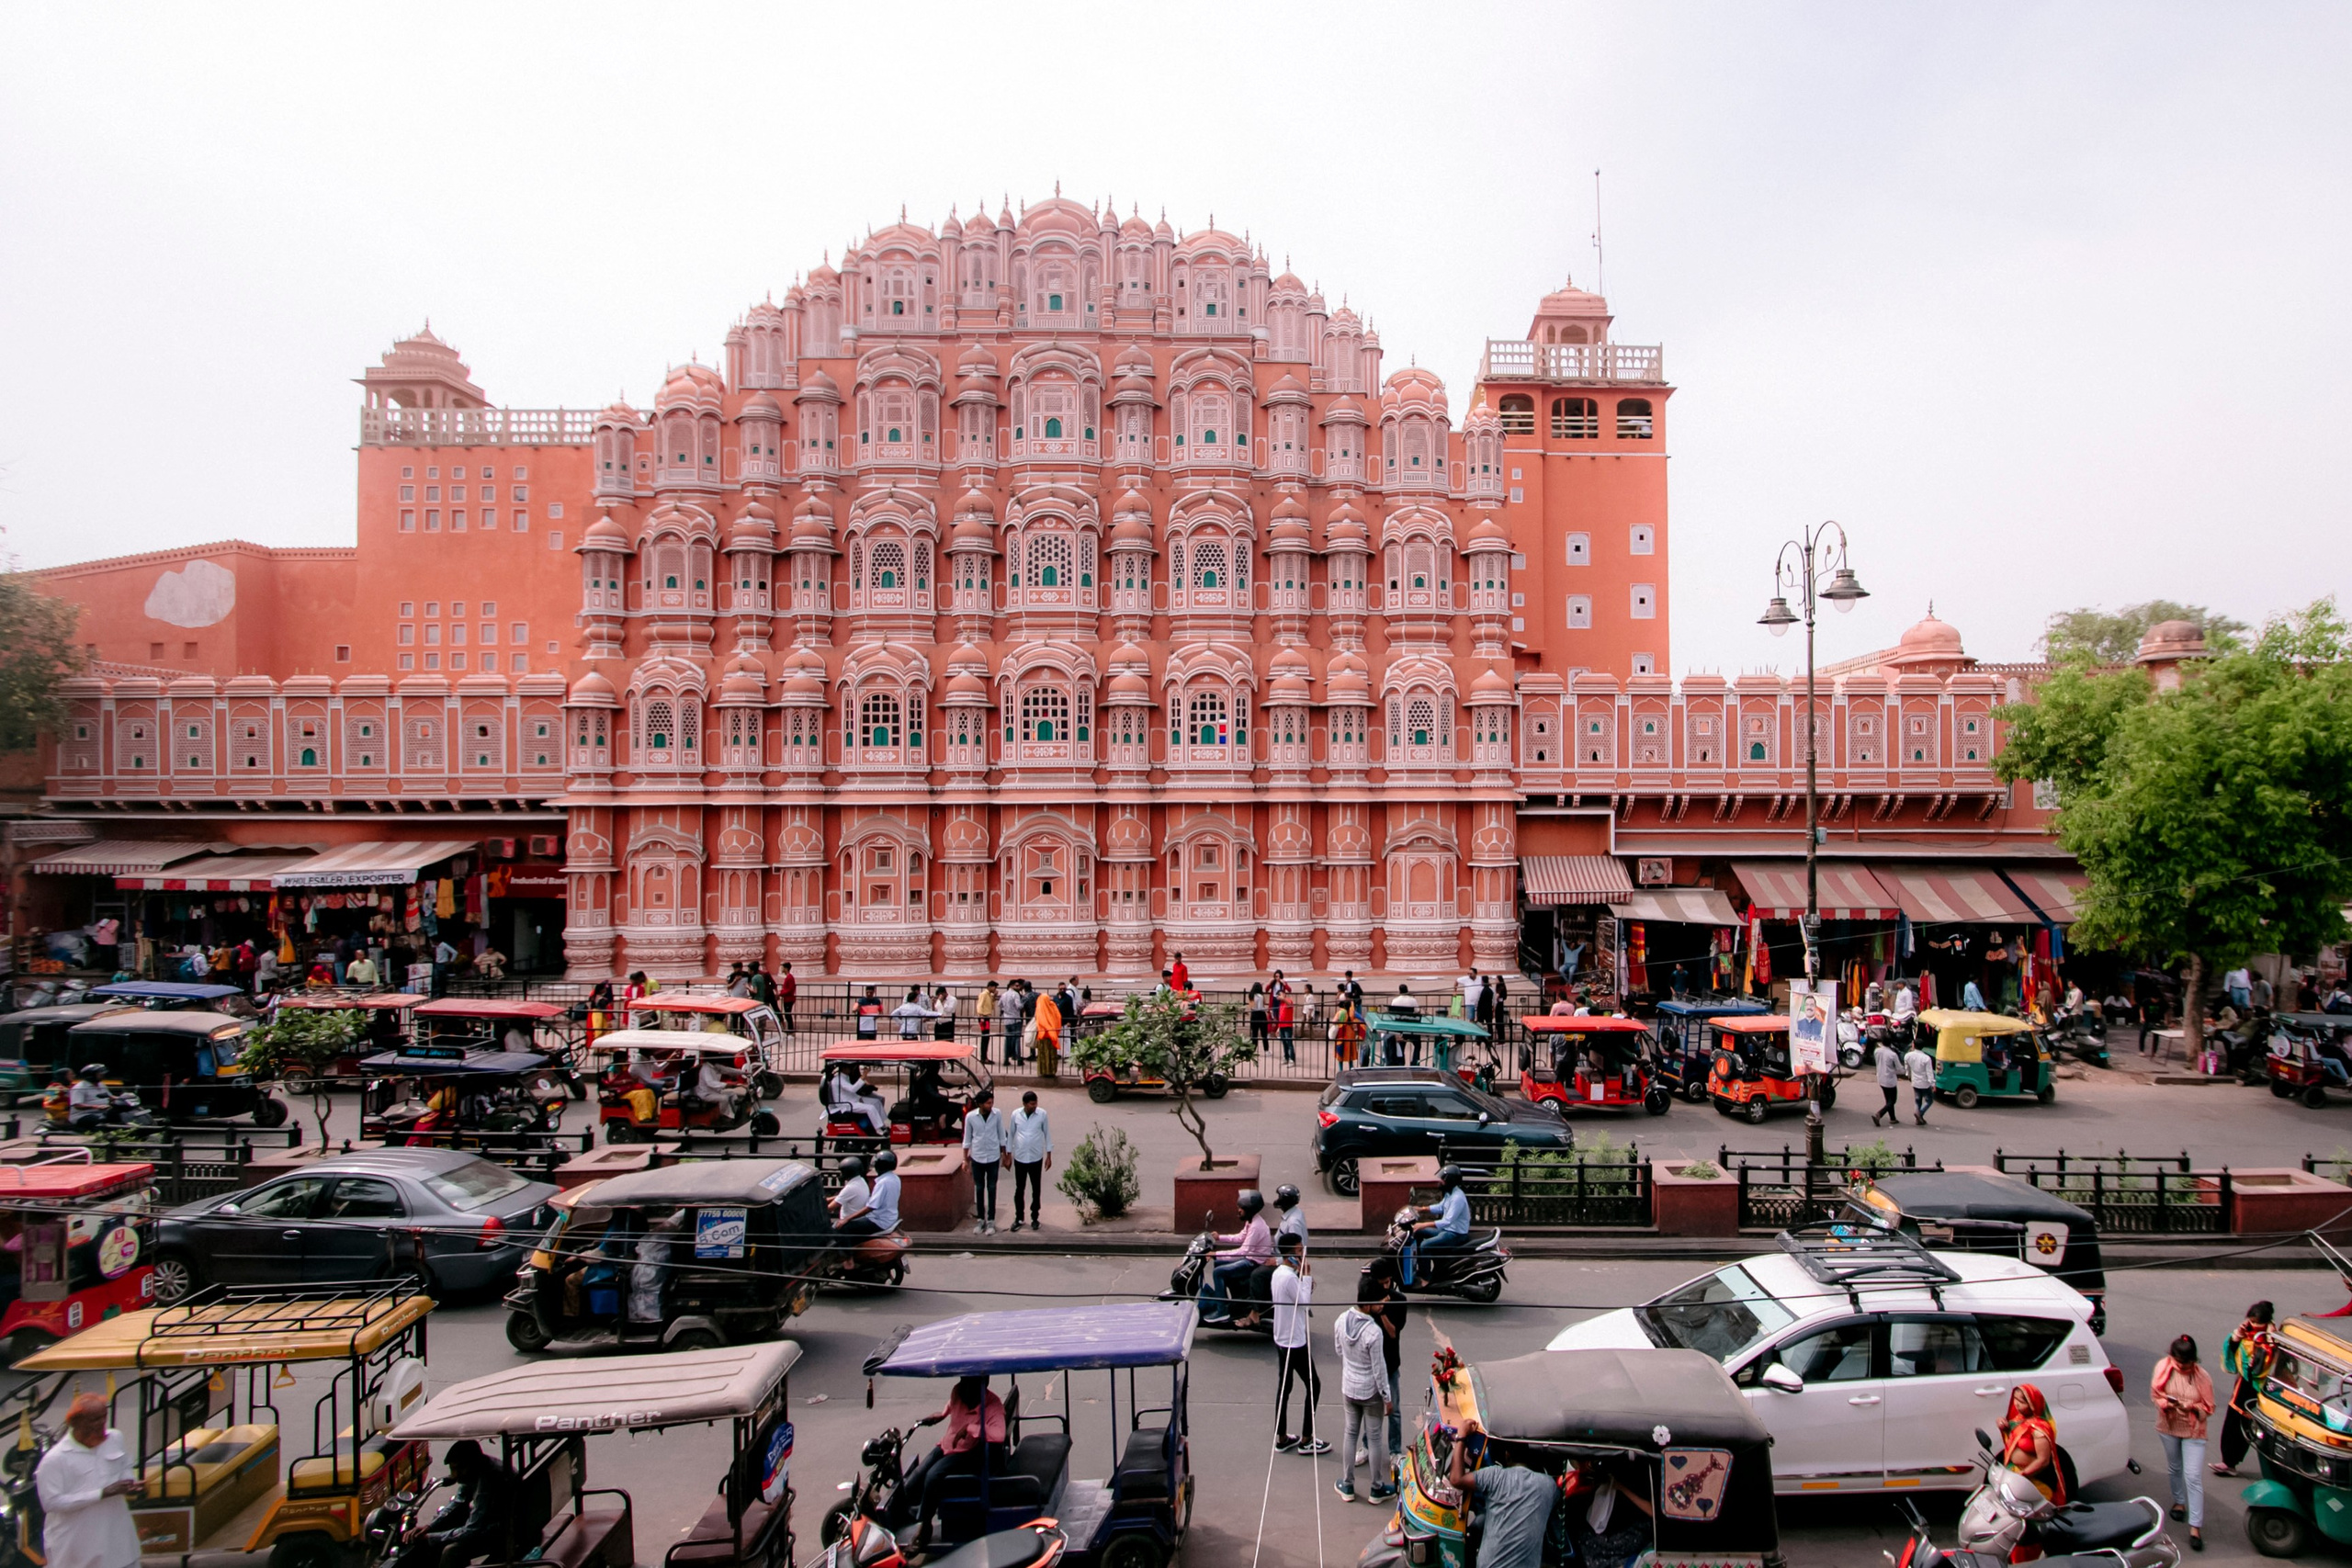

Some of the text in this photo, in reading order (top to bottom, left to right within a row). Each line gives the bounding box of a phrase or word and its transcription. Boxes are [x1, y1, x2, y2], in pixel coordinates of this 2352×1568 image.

[285, 876, 343, 885] WHOLESALER
[698, 1224, 744, 1245] B.Com.
[379, 1308, 418, 1336] Panther
[184, 1347, 296, 1363] Panther
[535, 1409, 662, 1431] Panther
